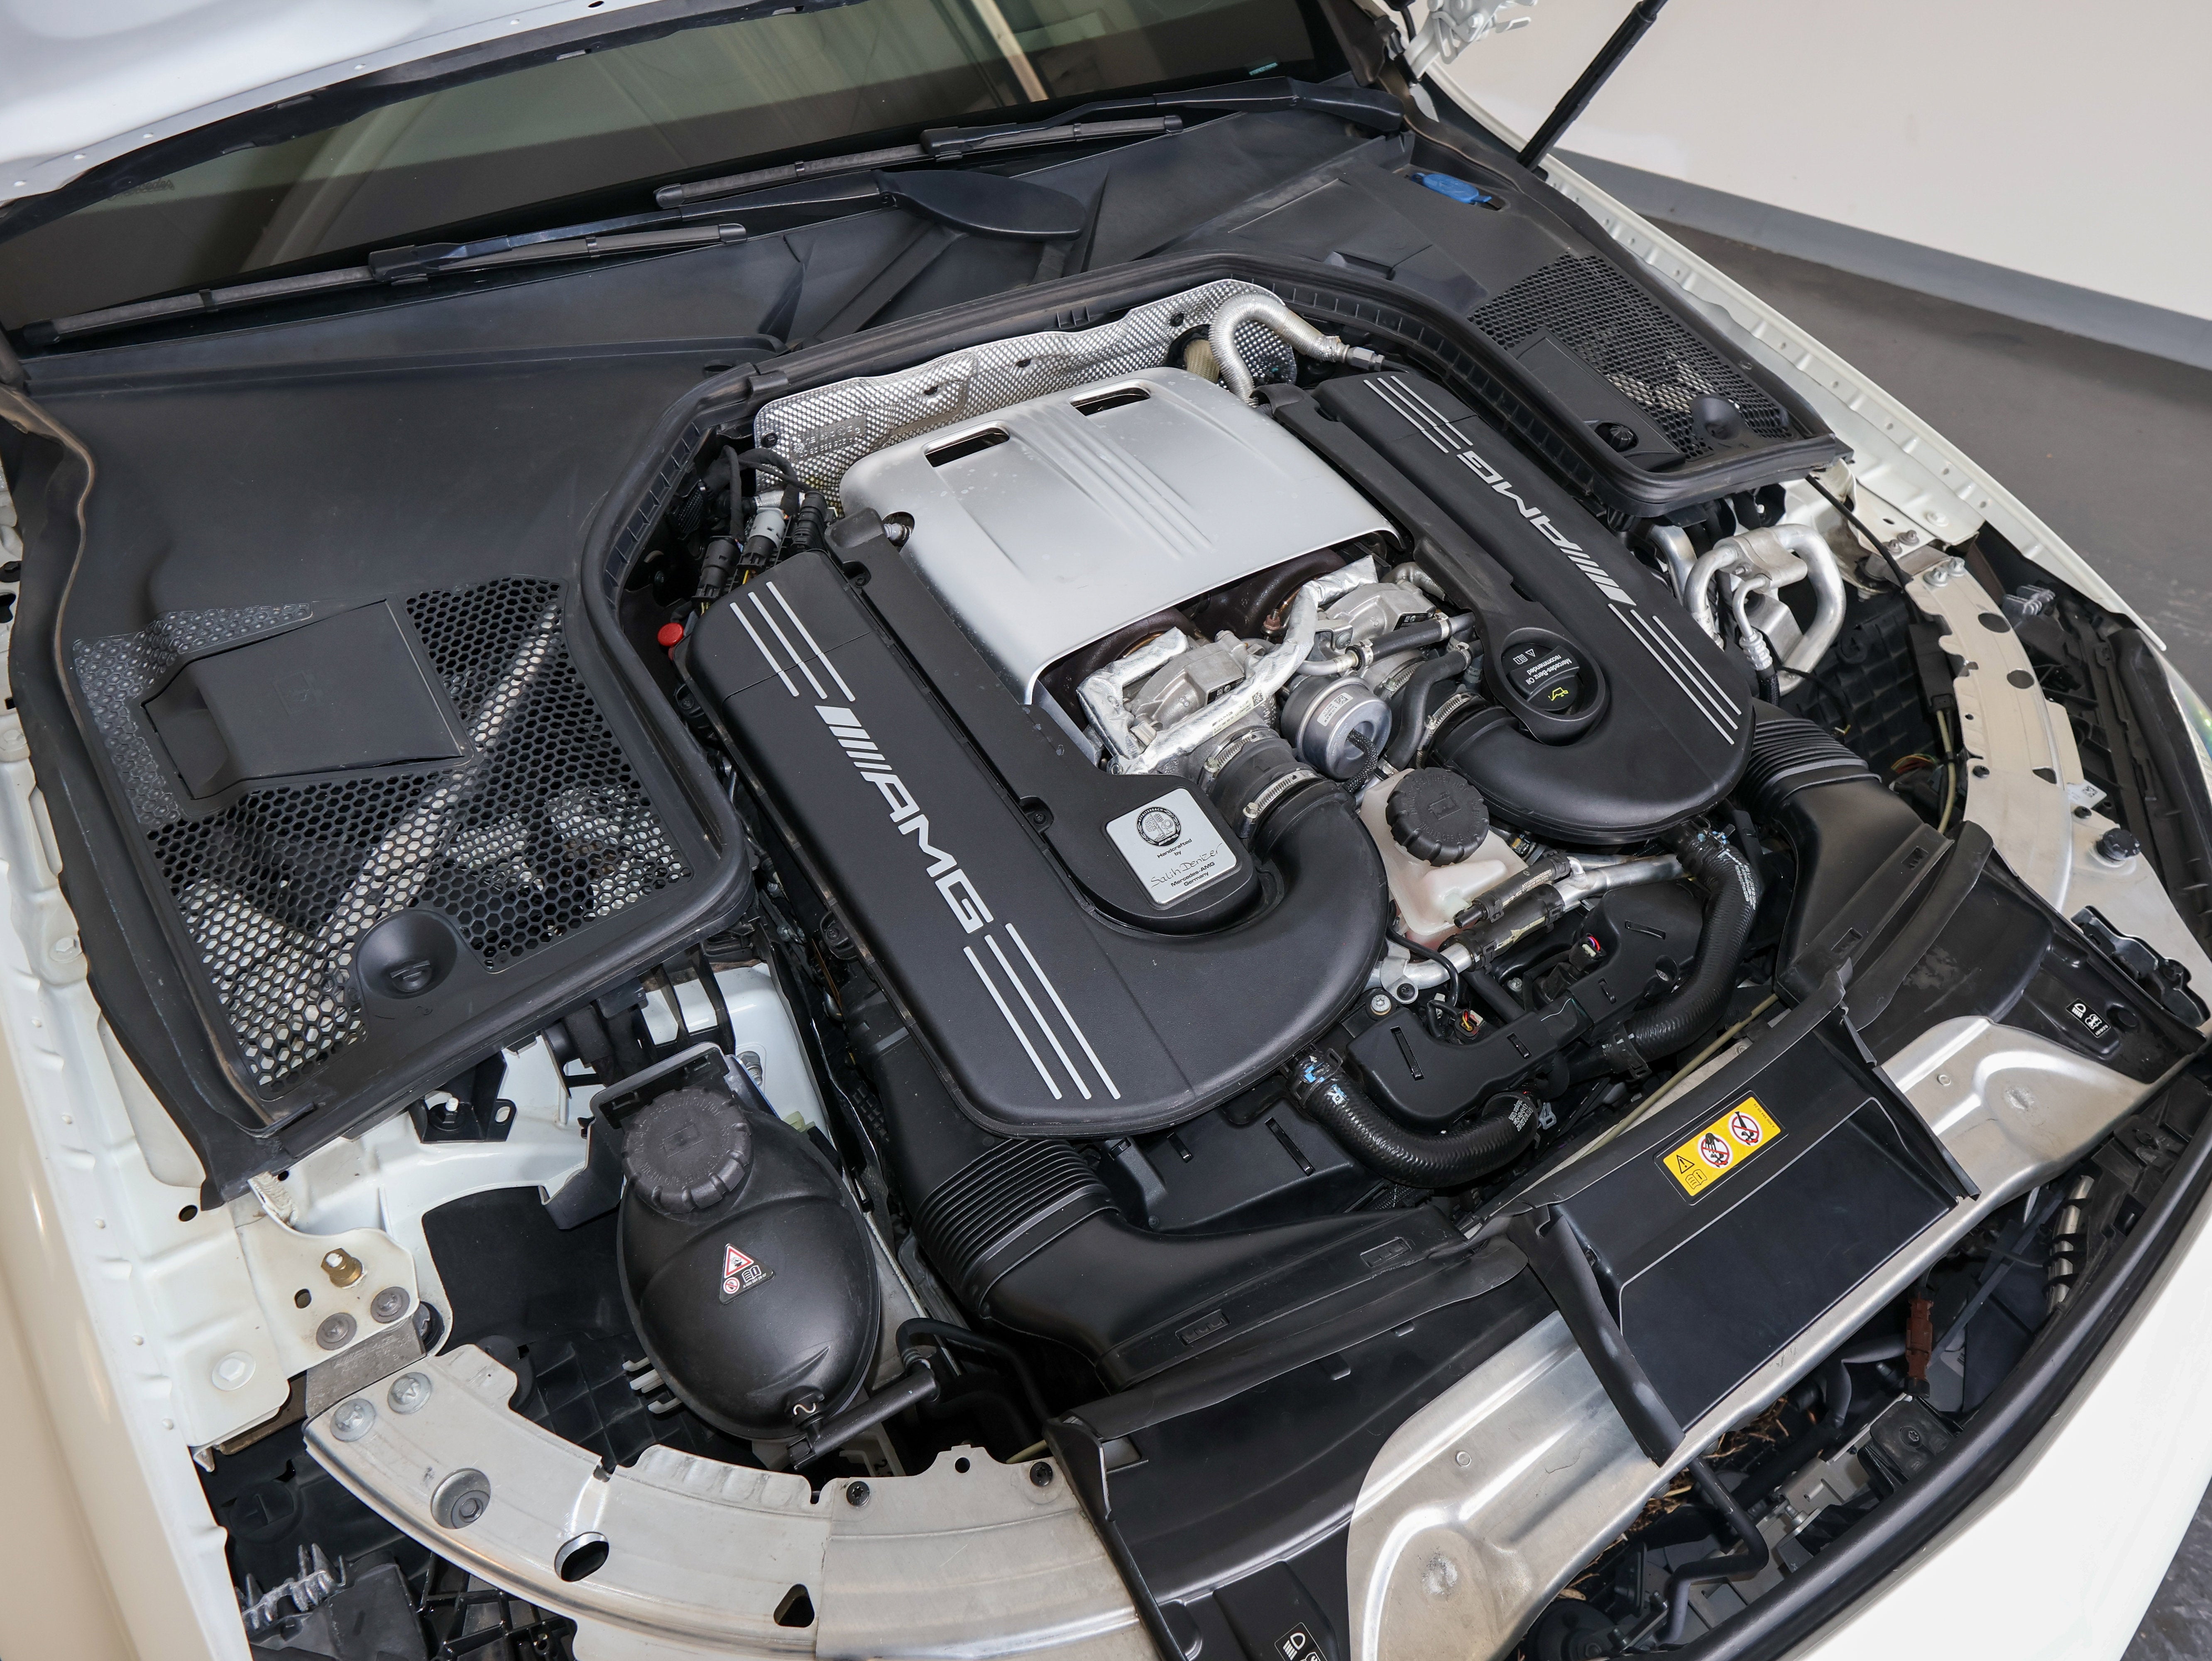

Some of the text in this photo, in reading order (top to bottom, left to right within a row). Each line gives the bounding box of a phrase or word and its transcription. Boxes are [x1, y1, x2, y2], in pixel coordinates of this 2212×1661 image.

[1457, 451, 1582, 551] AMG
[1527, 655, 1561, 676] recommended
[1534, 658, 1572, 680] Mercedes-Benz
[1138, 808, 1163, 822] AFFALTERBACH
[860, 771, 993, 933] AMG
[1157, 838, 1192, 858] Handcrafted
[1150, 843, 1222, 888] Salih Denizer
[1171, 861, 1215, 887] Mercedes-AMG
[1184, 872, 1209, 887] Germany
